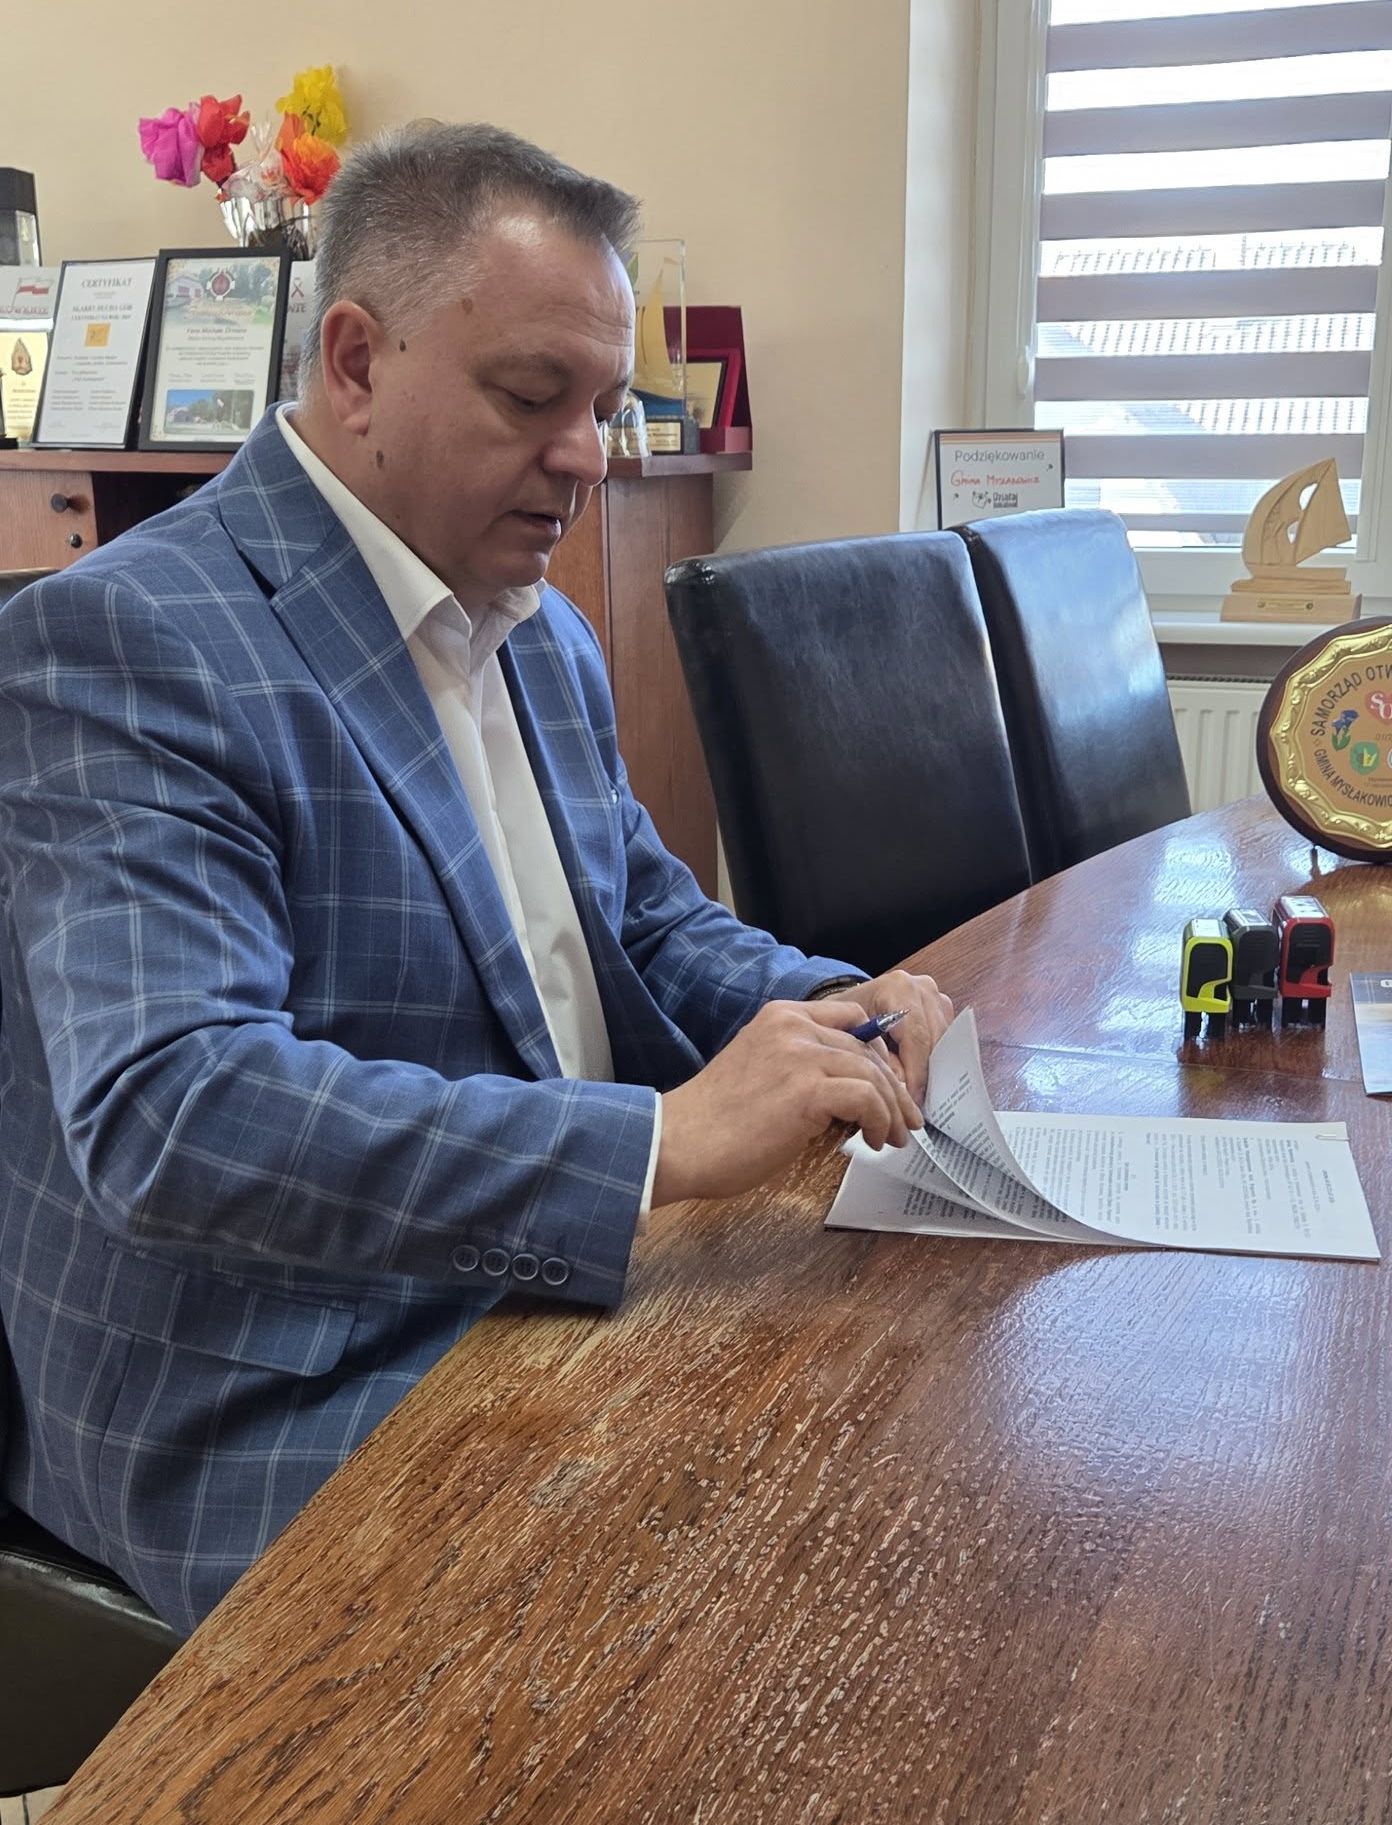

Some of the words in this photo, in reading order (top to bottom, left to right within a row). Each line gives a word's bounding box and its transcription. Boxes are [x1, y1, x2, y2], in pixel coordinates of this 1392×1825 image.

[81, 278, 132, 288] CERTYFIKAT
[954, 448, 1044, 463] Podziękowanie
[1310, 672, 1362, 736] SAMORZĄD
[1314, 748, 1336, 779] GMINA
